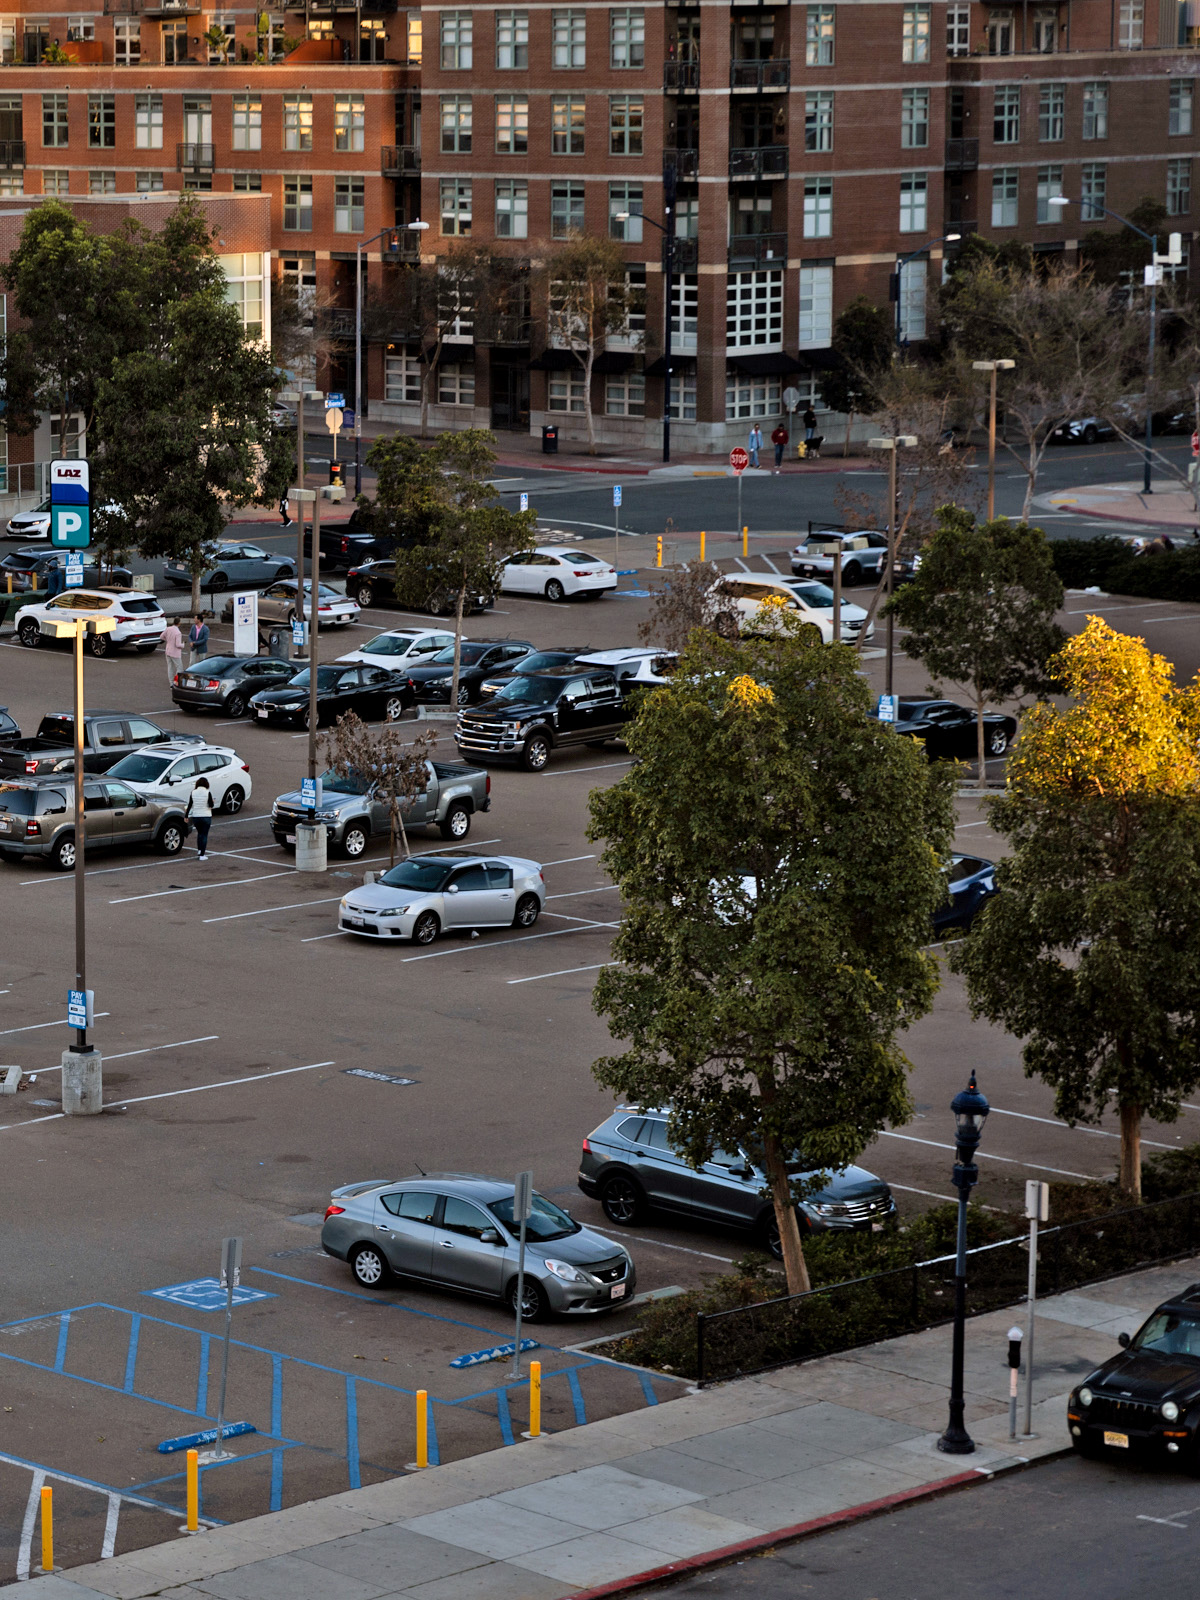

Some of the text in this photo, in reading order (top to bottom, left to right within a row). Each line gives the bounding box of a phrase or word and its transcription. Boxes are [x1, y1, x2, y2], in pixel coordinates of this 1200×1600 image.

[731, 454, 747, 464] STOP
[57, 469, 81, 477] LAZ
[58, 512, 82, 540] P
[68, 553, 81, 561] PAY
[303, 778, 314, 786] PAY
[71, 991, 83, 1000] PAY
[71, 998, 83, 1006] HERE
